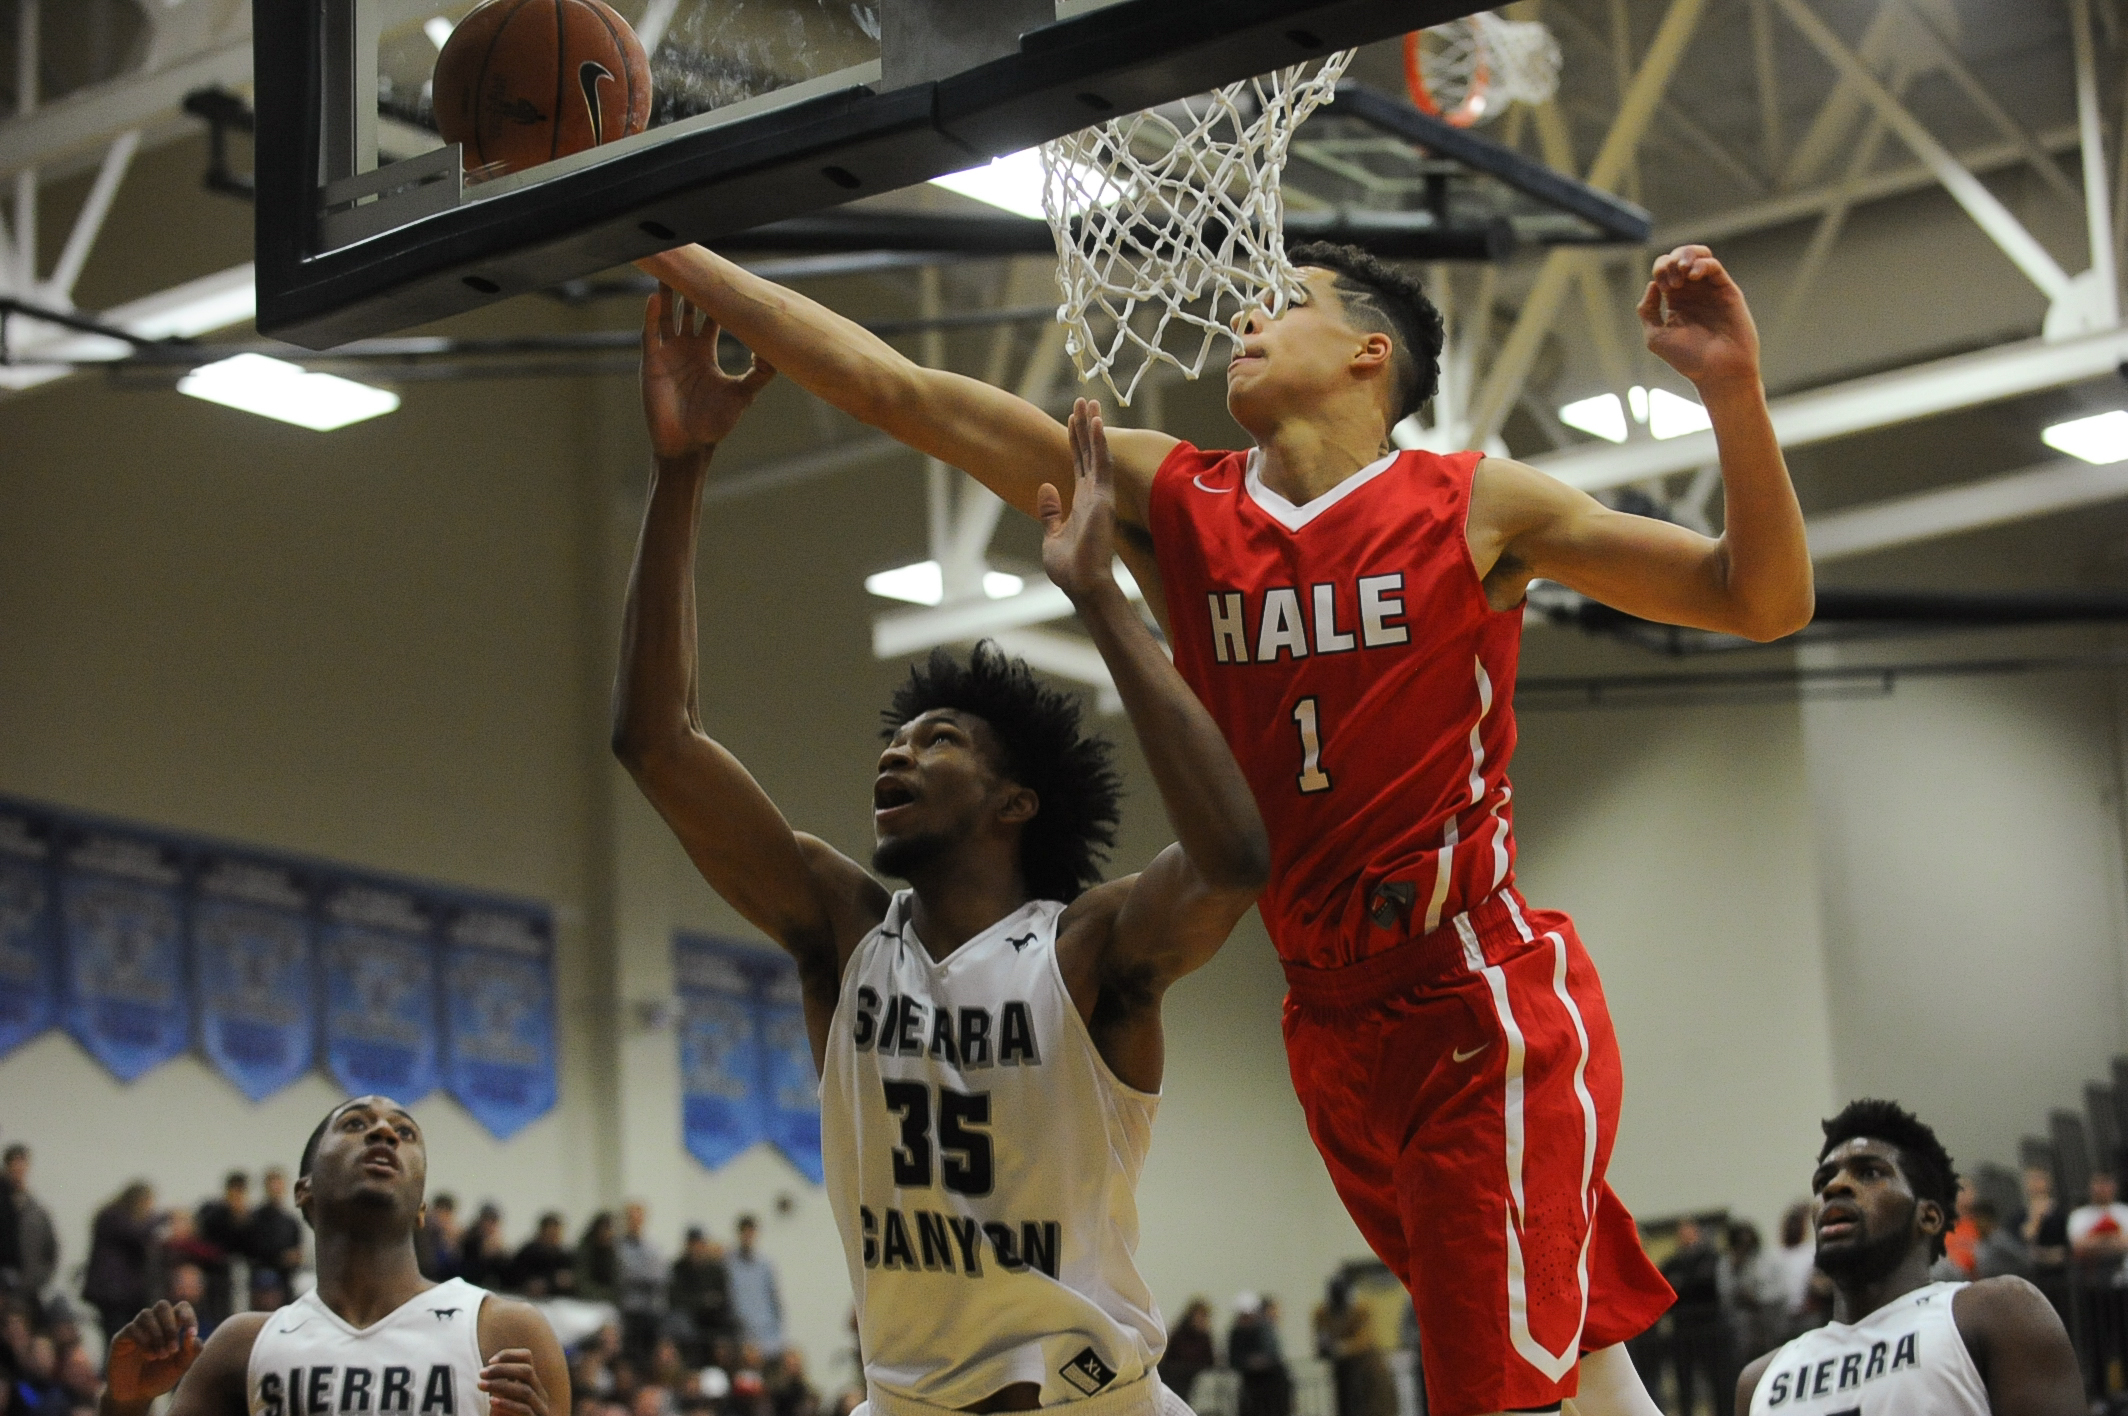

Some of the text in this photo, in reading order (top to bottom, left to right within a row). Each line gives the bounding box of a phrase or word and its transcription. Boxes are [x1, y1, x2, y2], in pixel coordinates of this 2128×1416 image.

[1207, 571, 1410, 664] HALE
[1292, 695, 1331, 793] 1
[854, 985, 1042, 1069] SIERRA
[884, 1079, 996, 1198] 35
[859, 1205, 1062, 1281] CANYON
[261, 1364, 457, 1416] SIERRA
[1769, 1331, 1920, 1407] SIERRA
